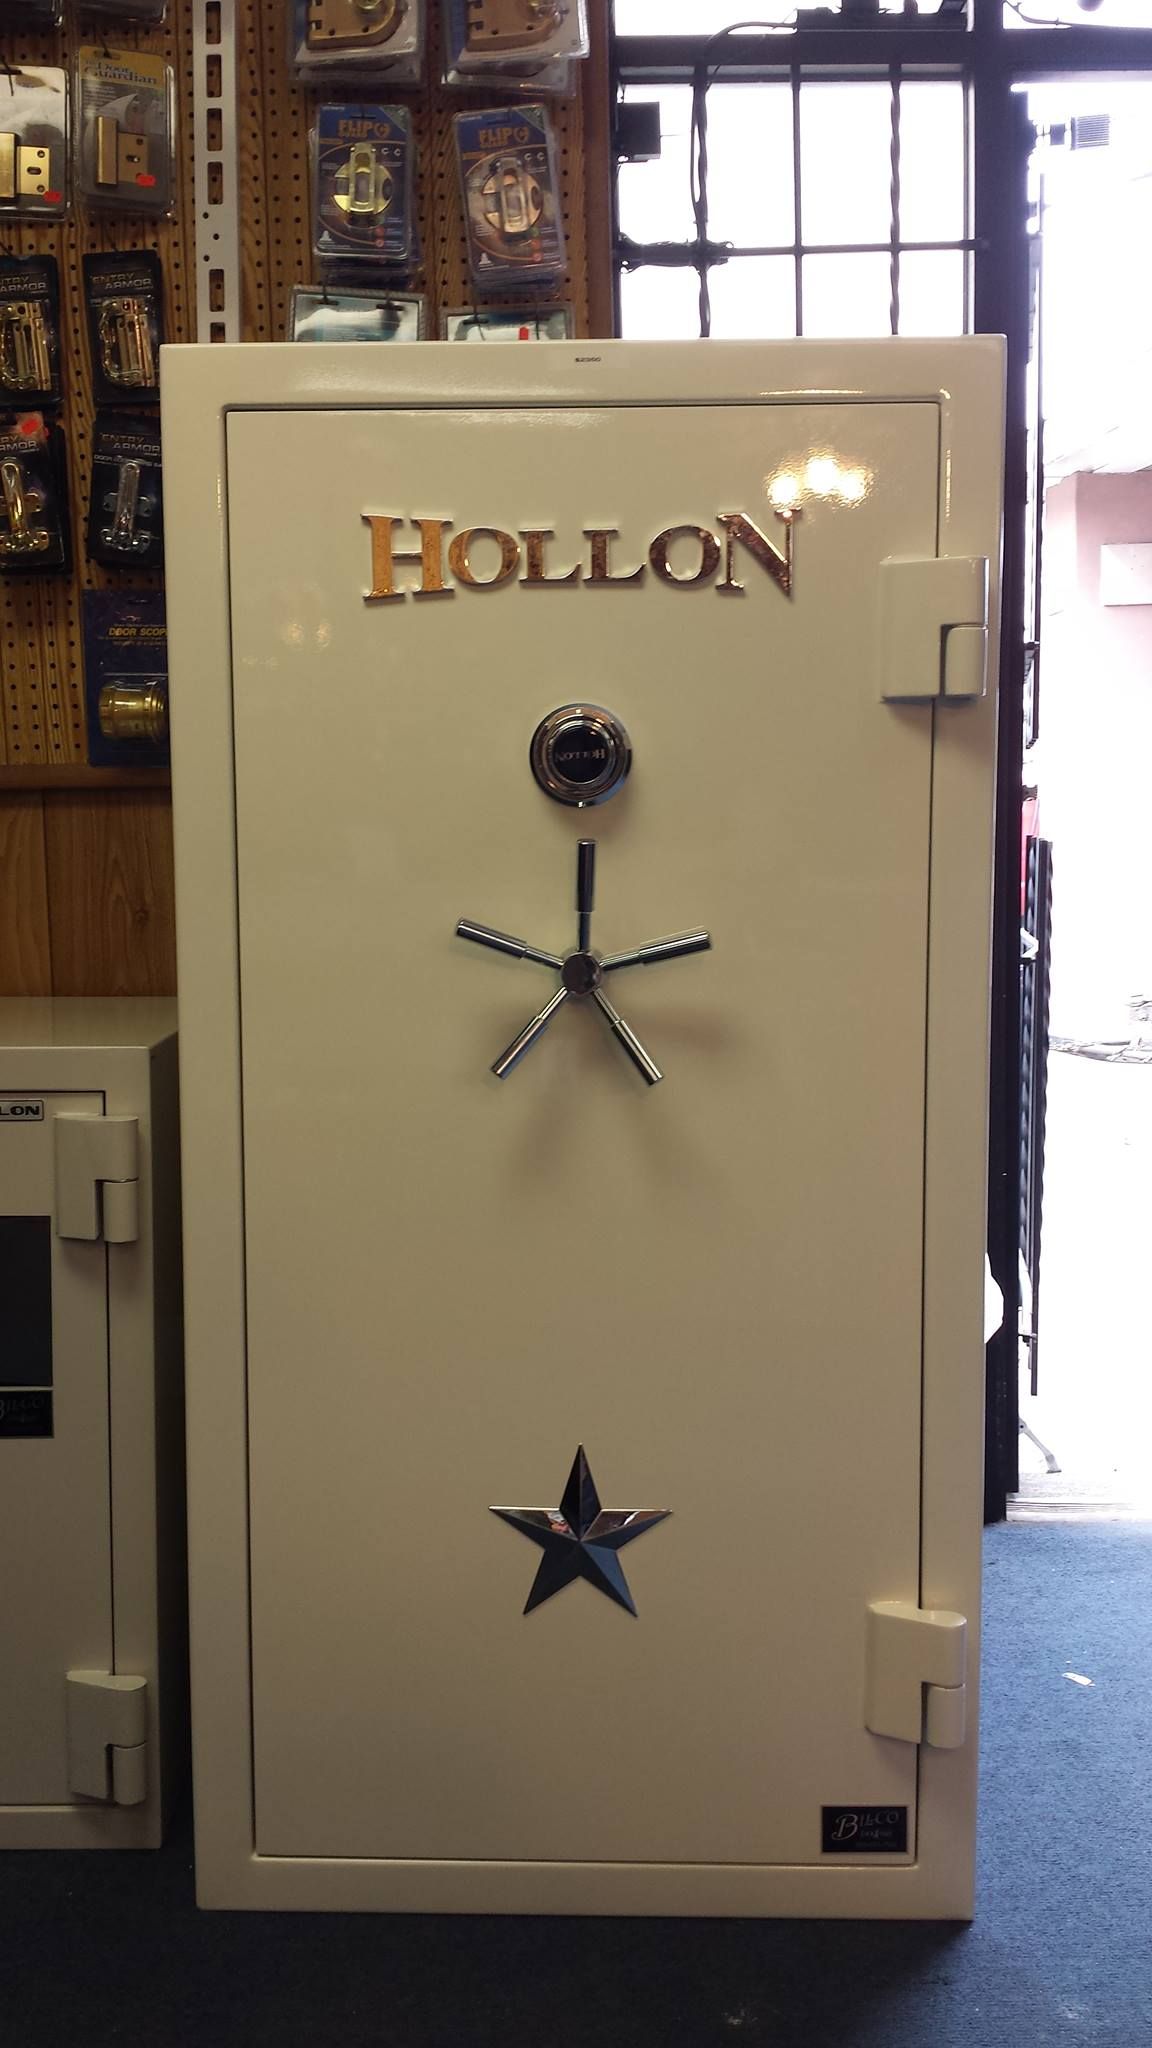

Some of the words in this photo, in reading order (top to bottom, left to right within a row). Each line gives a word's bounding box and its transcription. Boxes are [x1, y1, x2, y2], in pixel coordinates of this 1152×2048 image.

[105, 278, 152, 290] ARMOR
[360, 508, 801, 601] HOLLON
[108, 627, 137, 637] DOOR
